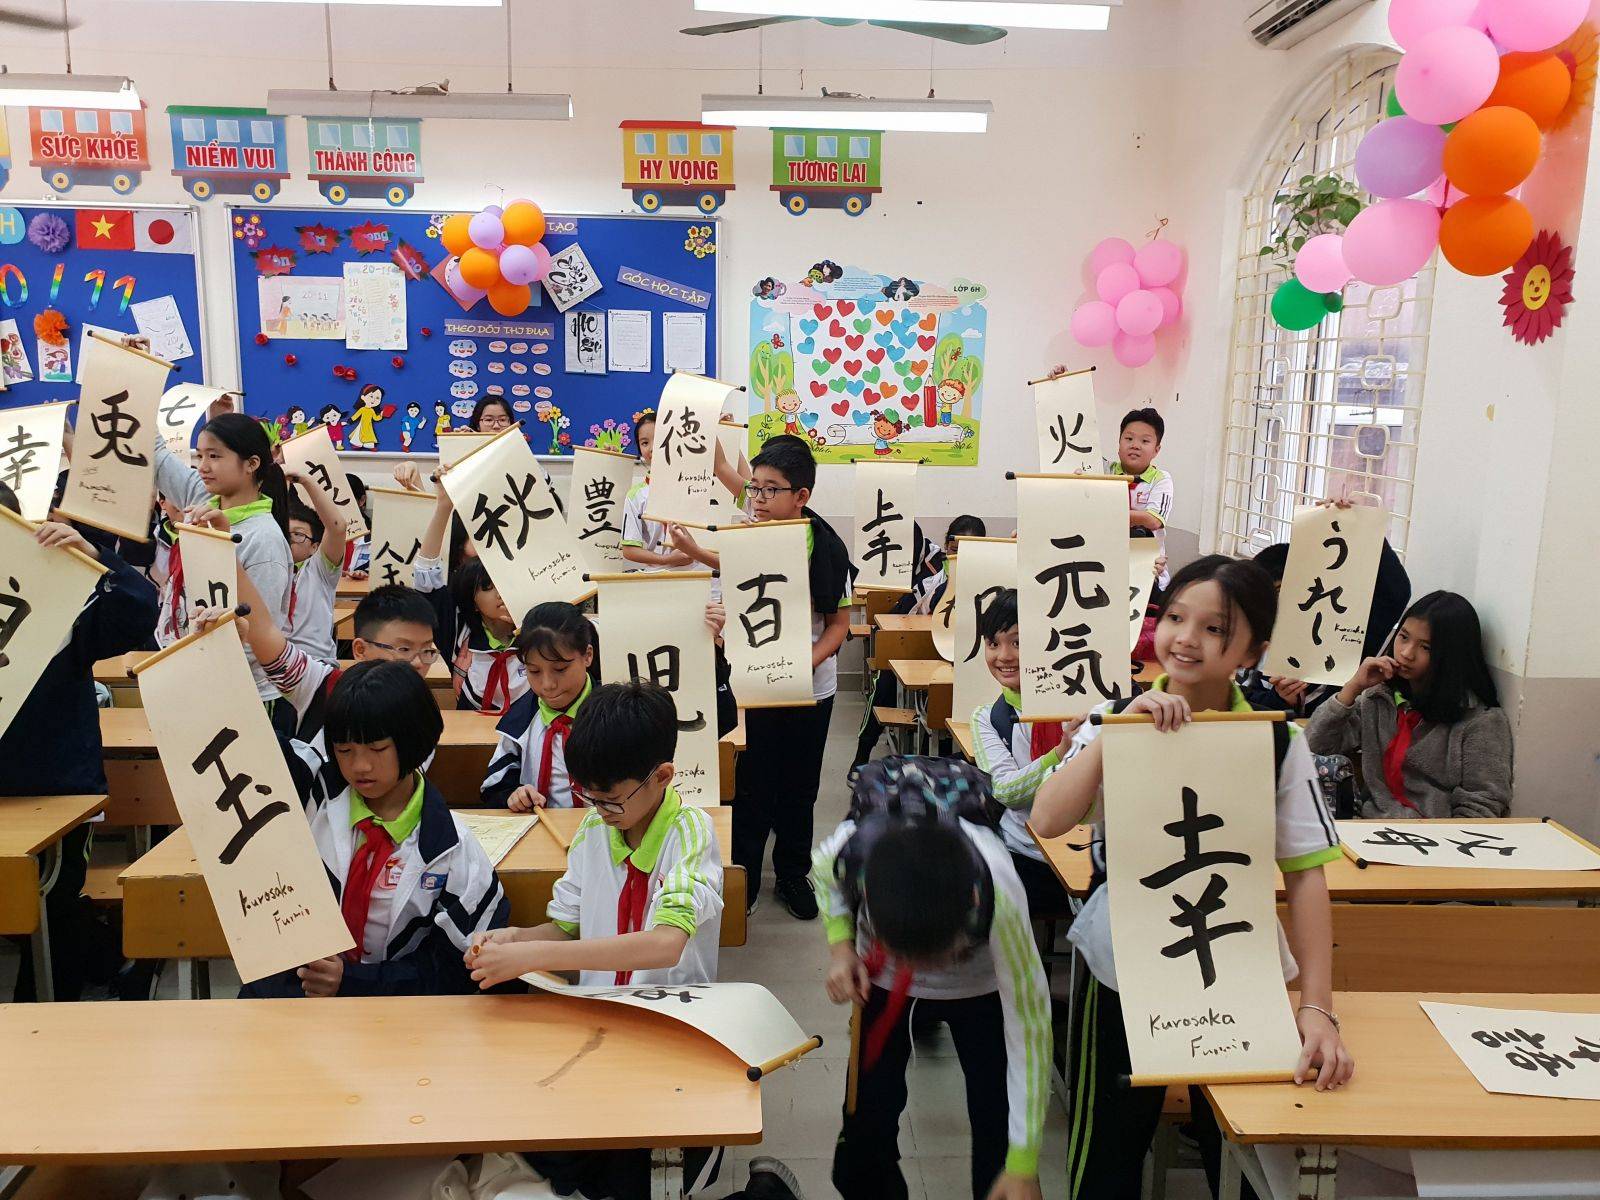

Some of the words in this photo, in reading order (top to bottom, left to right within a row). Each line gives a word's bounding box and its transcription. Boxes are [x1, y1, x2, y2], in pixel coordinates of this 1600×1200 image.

[40, 131, 80, 160] SỨC
[86, 130, 138, 161] KHỎE
[186, 138, 237, 168] NIỀM
[243, 148, 275, 169] VUI
[315, 146, 365, 172] THÀNH
[372, 148, 416, 173] CÔNG
[639, 160, 663, 180] HY
[667, 161, 719, 186] VỌNG
[788, 160, 838, 183] TƯƠNG
[843, 163, 867, 184] LAI
[622, 271, 649, 287] GÓC
[446, 323, 476, 333] THEO
[1049, 412, 1093, 465] 火
[471, 472, 555, 561] 秋
[861, 488, 904, 577] 上手
[736, 573, 788, 648] 百
[1034, 534, 1122, 700] 元気
[1287, 520, 1349, 672] うれしい
[191, 727, 290, 865] 玉
[1139, 786, 1253, 989] 幸
[1149, 1007, 1235, 1038] Kurosaka
